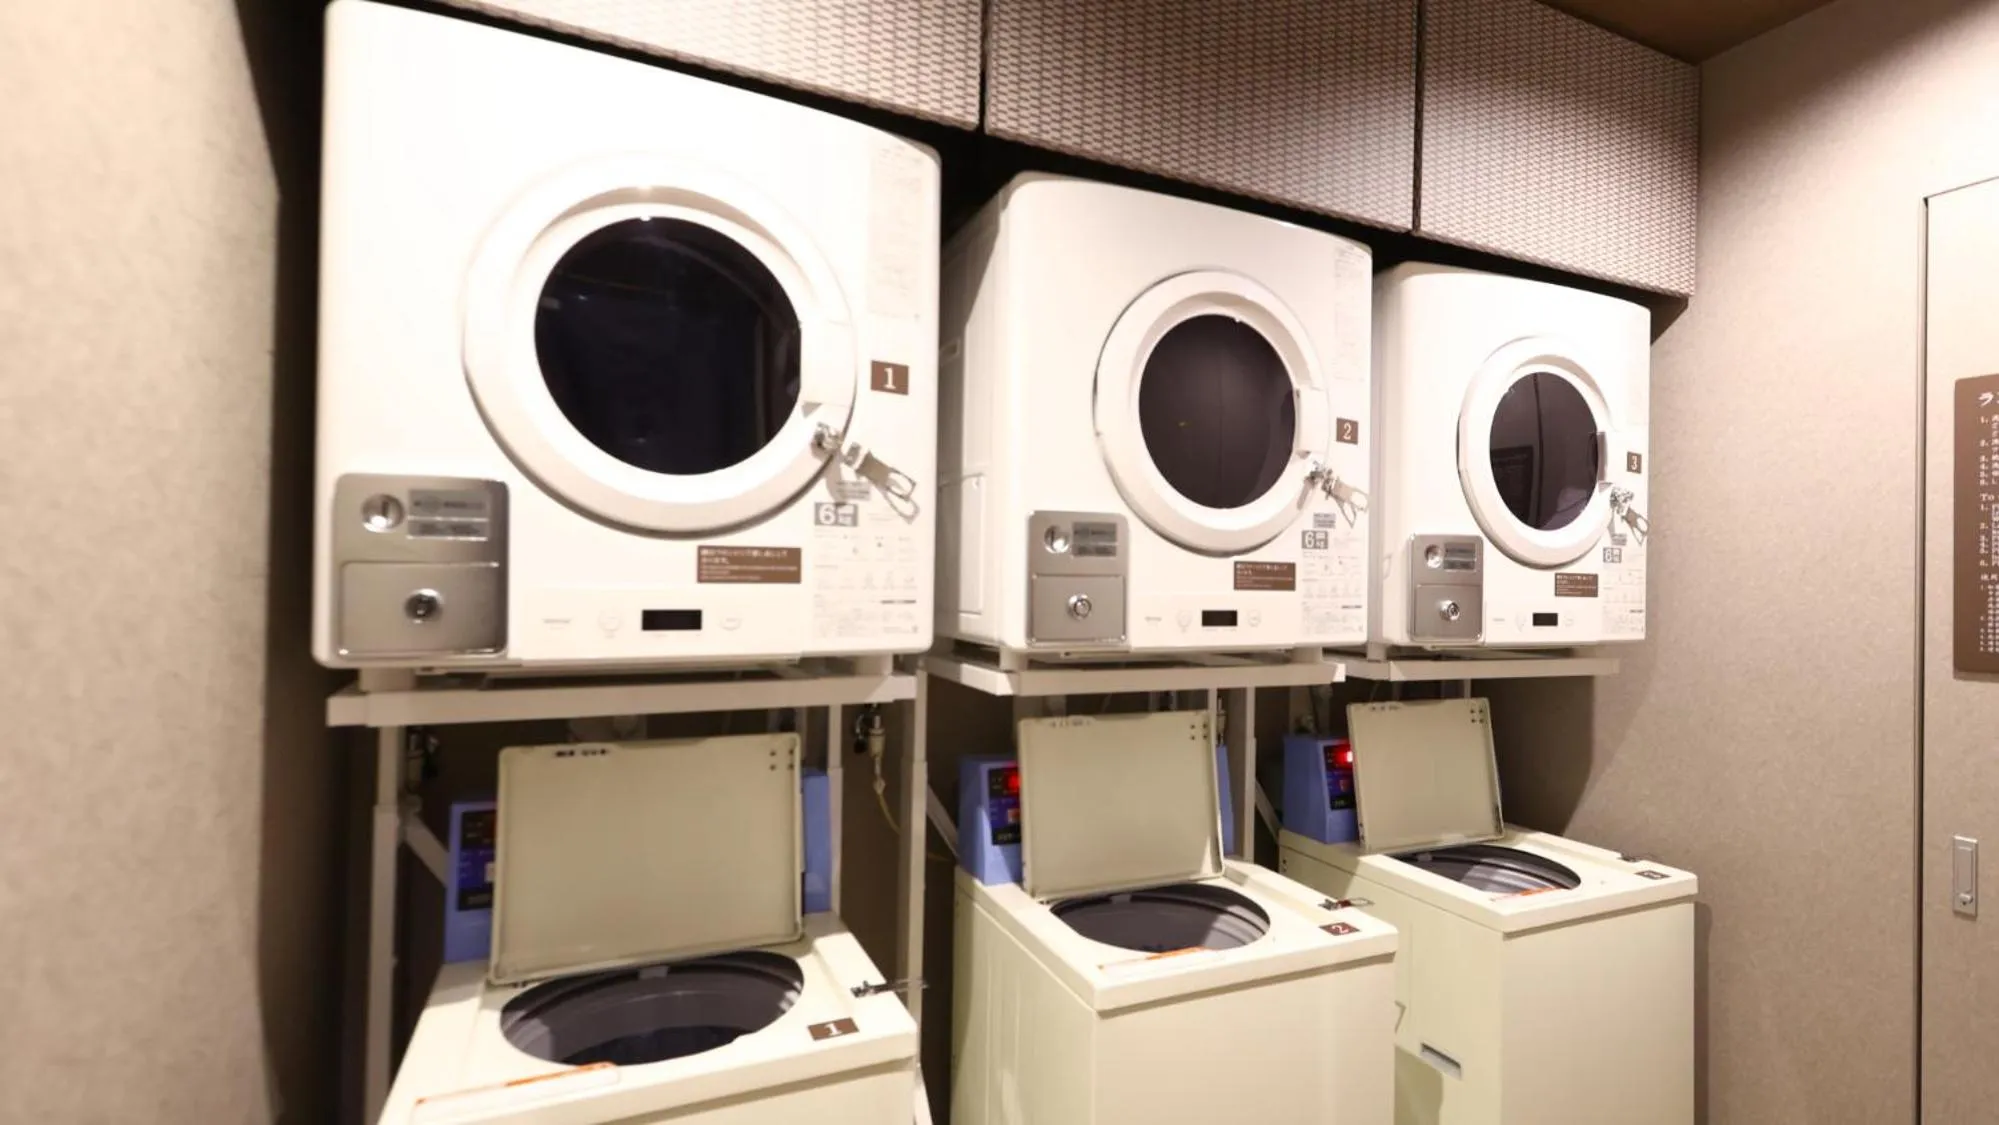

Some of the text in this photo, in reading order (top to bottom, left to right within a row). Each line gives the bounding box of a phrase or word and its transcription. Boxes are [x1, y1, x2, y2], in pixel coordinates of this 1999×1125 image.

[883, 367, 897, 390] 1
[1343, 422, 1352, 440] 2
[1631, 455, 1638, 470] 3
[1331, 924, 1350, 935] 2
[823, 1022, 842, 1037] 1
